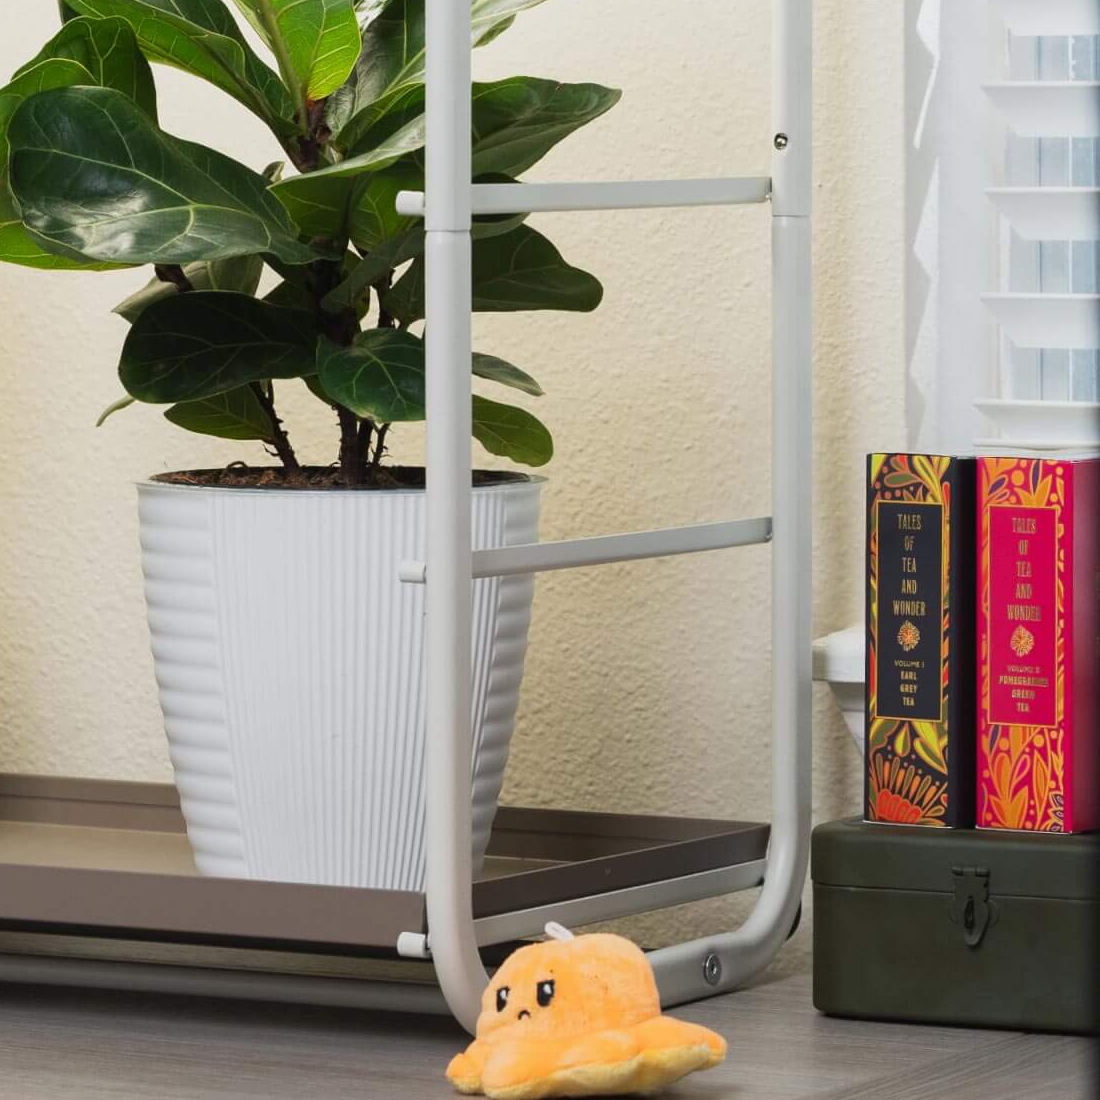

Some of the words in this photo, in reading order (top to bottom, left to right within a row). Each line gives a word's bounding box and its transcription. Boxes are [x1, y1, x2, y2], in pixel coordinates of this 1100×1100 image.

[897, 513, 922, 530] TALES
[1012, 517, 1036, 534] TALES
[904, 535, 915, 551] OF
[902, 557, 917, 573] TEA
[1016, 561, 1032, 578] TEA
[901, 579, 917, 595] AND
[1015, 583, 1032, 600] AND
[893, 600, 926, 616] WONDER
[1007, 604, 1042, 621] WONDER
[900, 670, 917, 680] EARL
[903, 696, 915, 707] TEA
